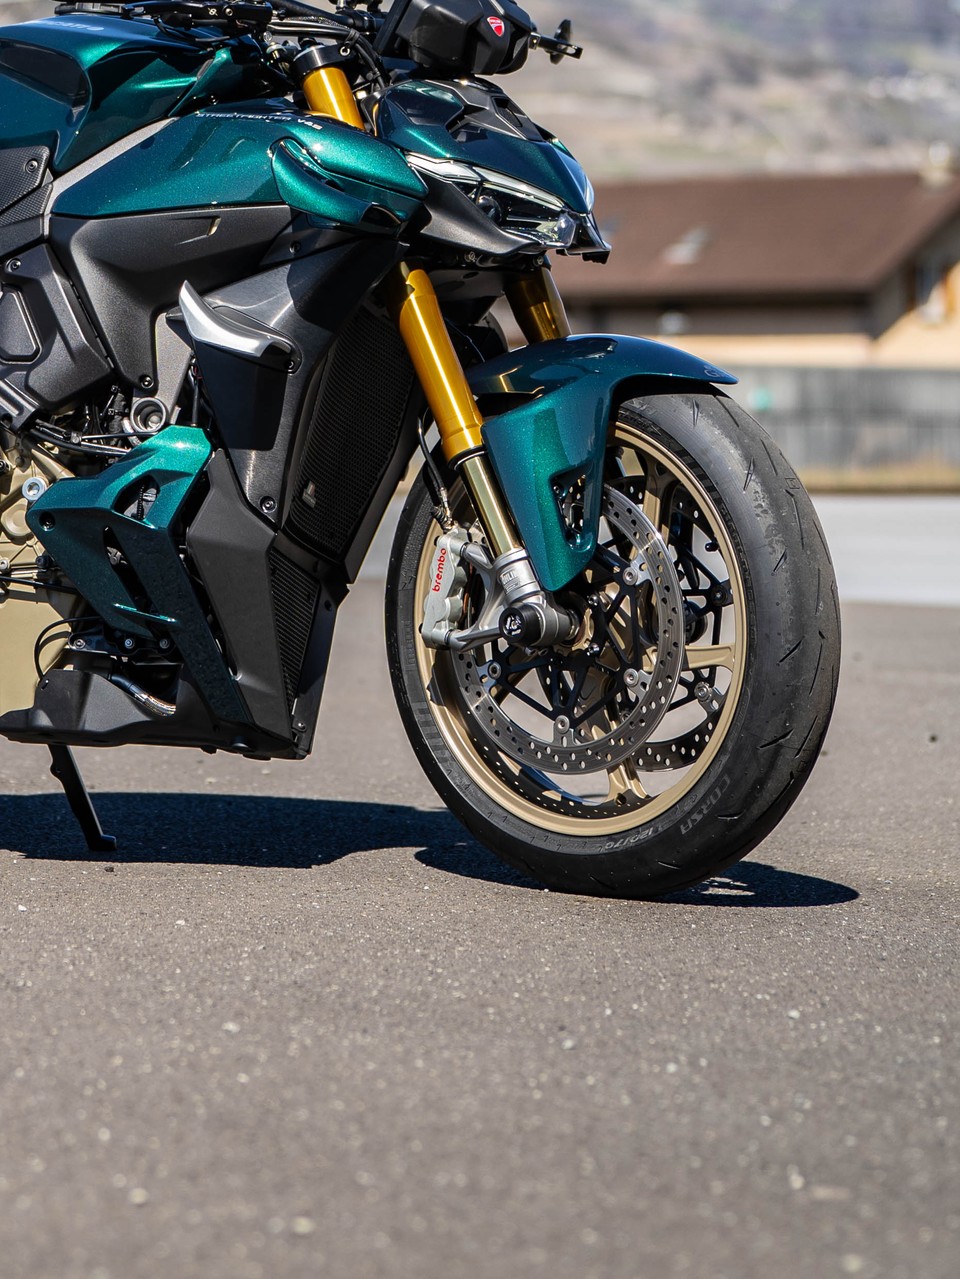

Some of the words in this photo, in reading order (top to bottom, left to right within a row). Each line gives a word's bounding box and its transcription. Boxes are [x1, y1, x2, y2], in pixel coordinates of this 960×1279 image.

[431, 548, 447, 592] brembo
[680, 773, 732, 835] CORSA
[604, 827, 654, 850] 120/70
